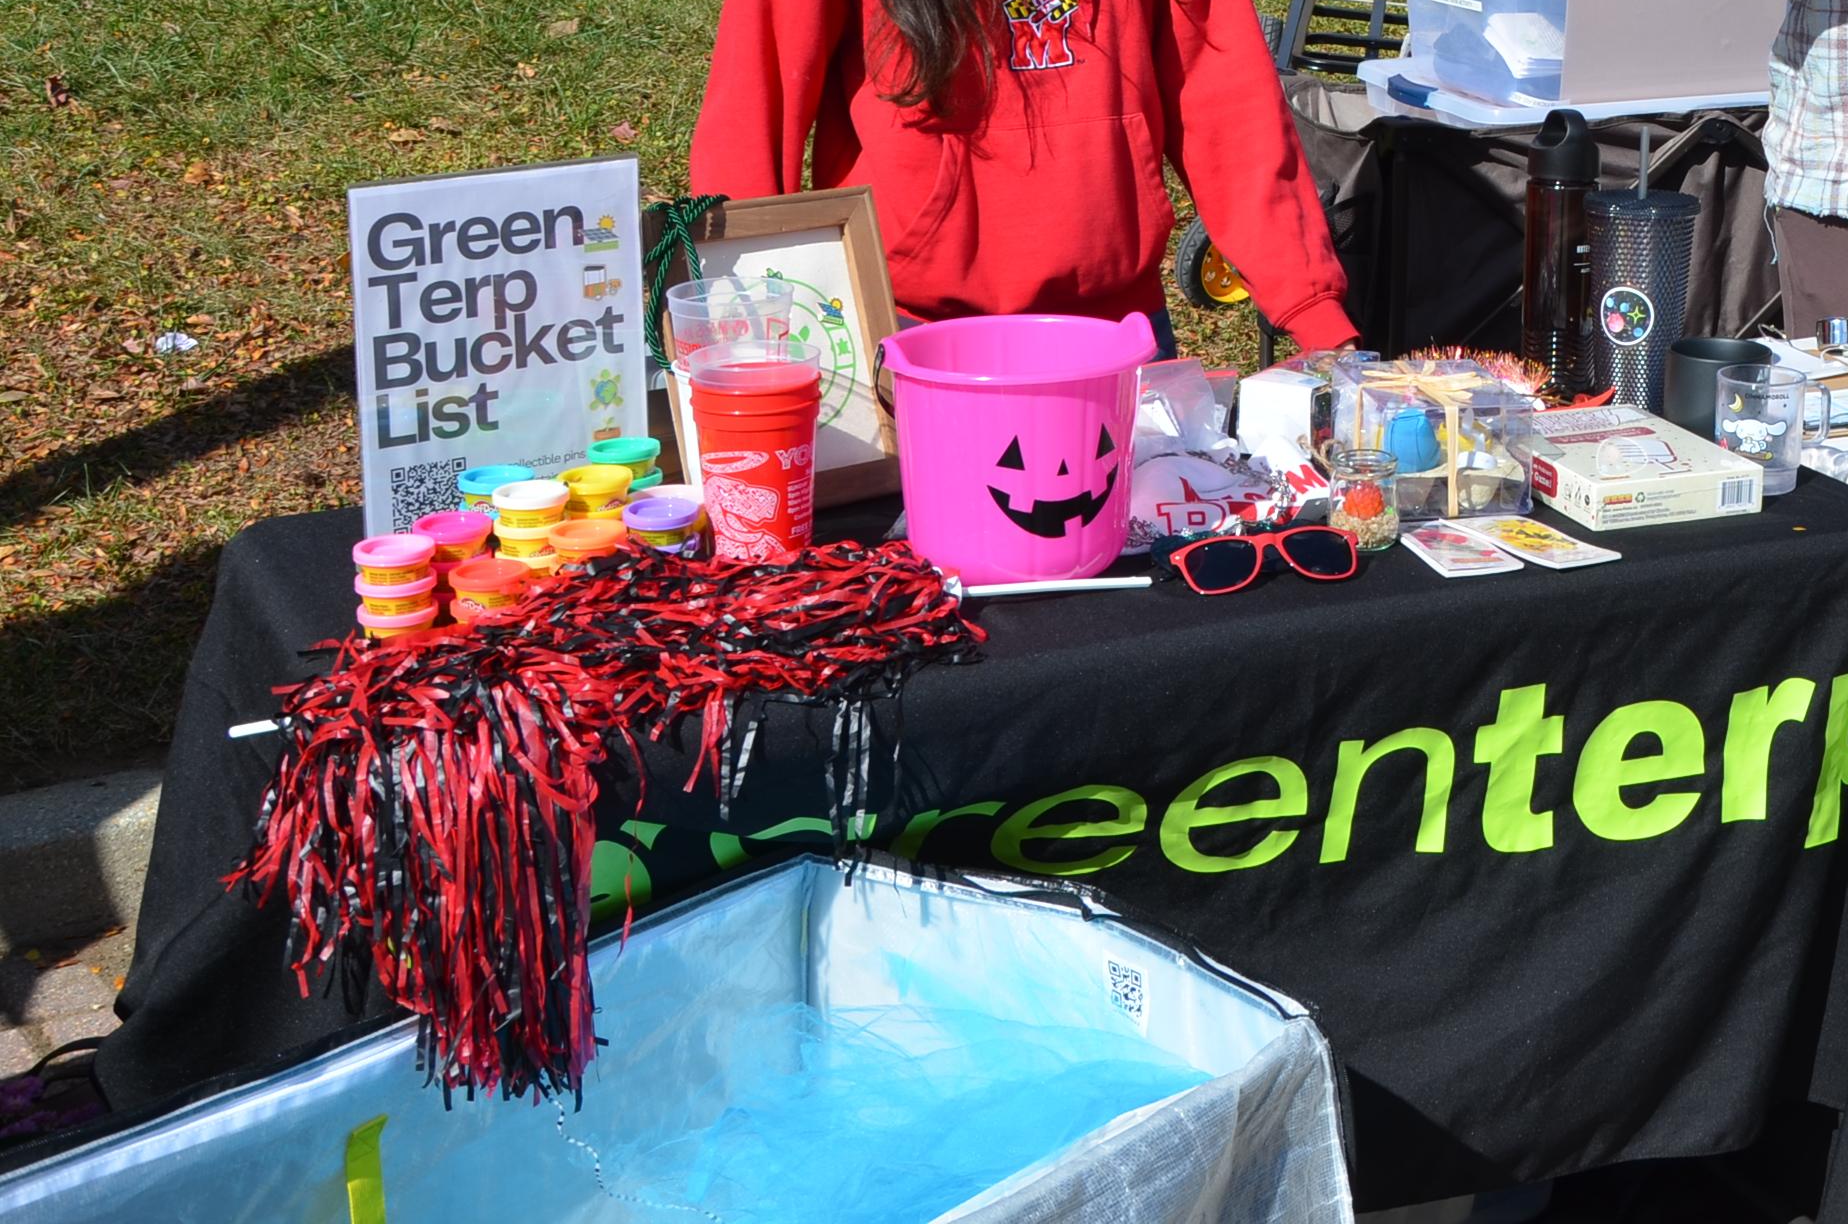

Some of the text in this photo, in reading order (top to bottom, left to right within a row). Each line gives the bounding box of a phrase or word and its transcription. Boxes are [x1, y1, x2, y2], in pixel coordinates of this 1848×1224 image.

[367, 205, 585, 271] Green
[368, 269, 538, 331] Terp
[372, 306, 625, 391] Bucket
[375, 382, 500, 449] List
[509, 450, 586, 469] llectible pins
